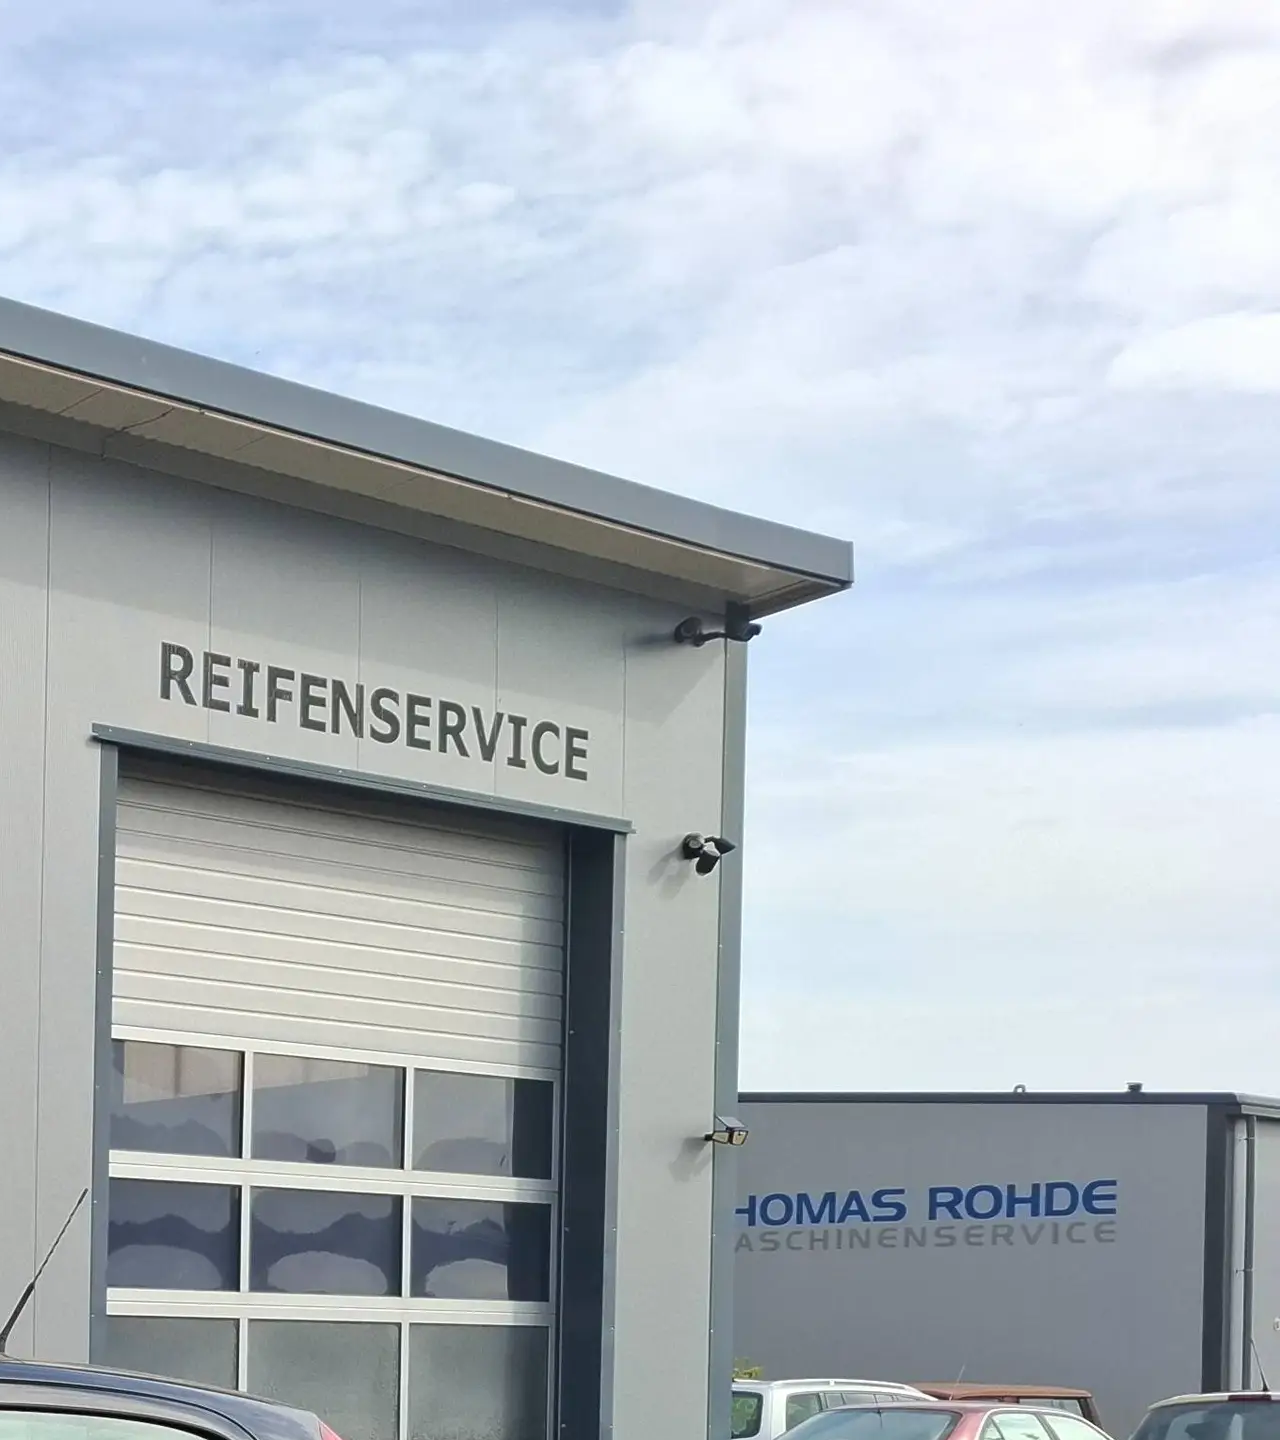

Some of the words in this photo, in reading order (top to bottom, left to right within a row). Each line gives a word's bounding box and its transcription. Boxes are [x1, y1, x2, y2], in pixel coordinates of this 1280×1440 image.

[159, 641, 589, 781] REIFENSERVICE
[928, 1179, 1117, 1221] ROHDE
[734, 1220, 1117, 1254] ASCHINENSERVICE
